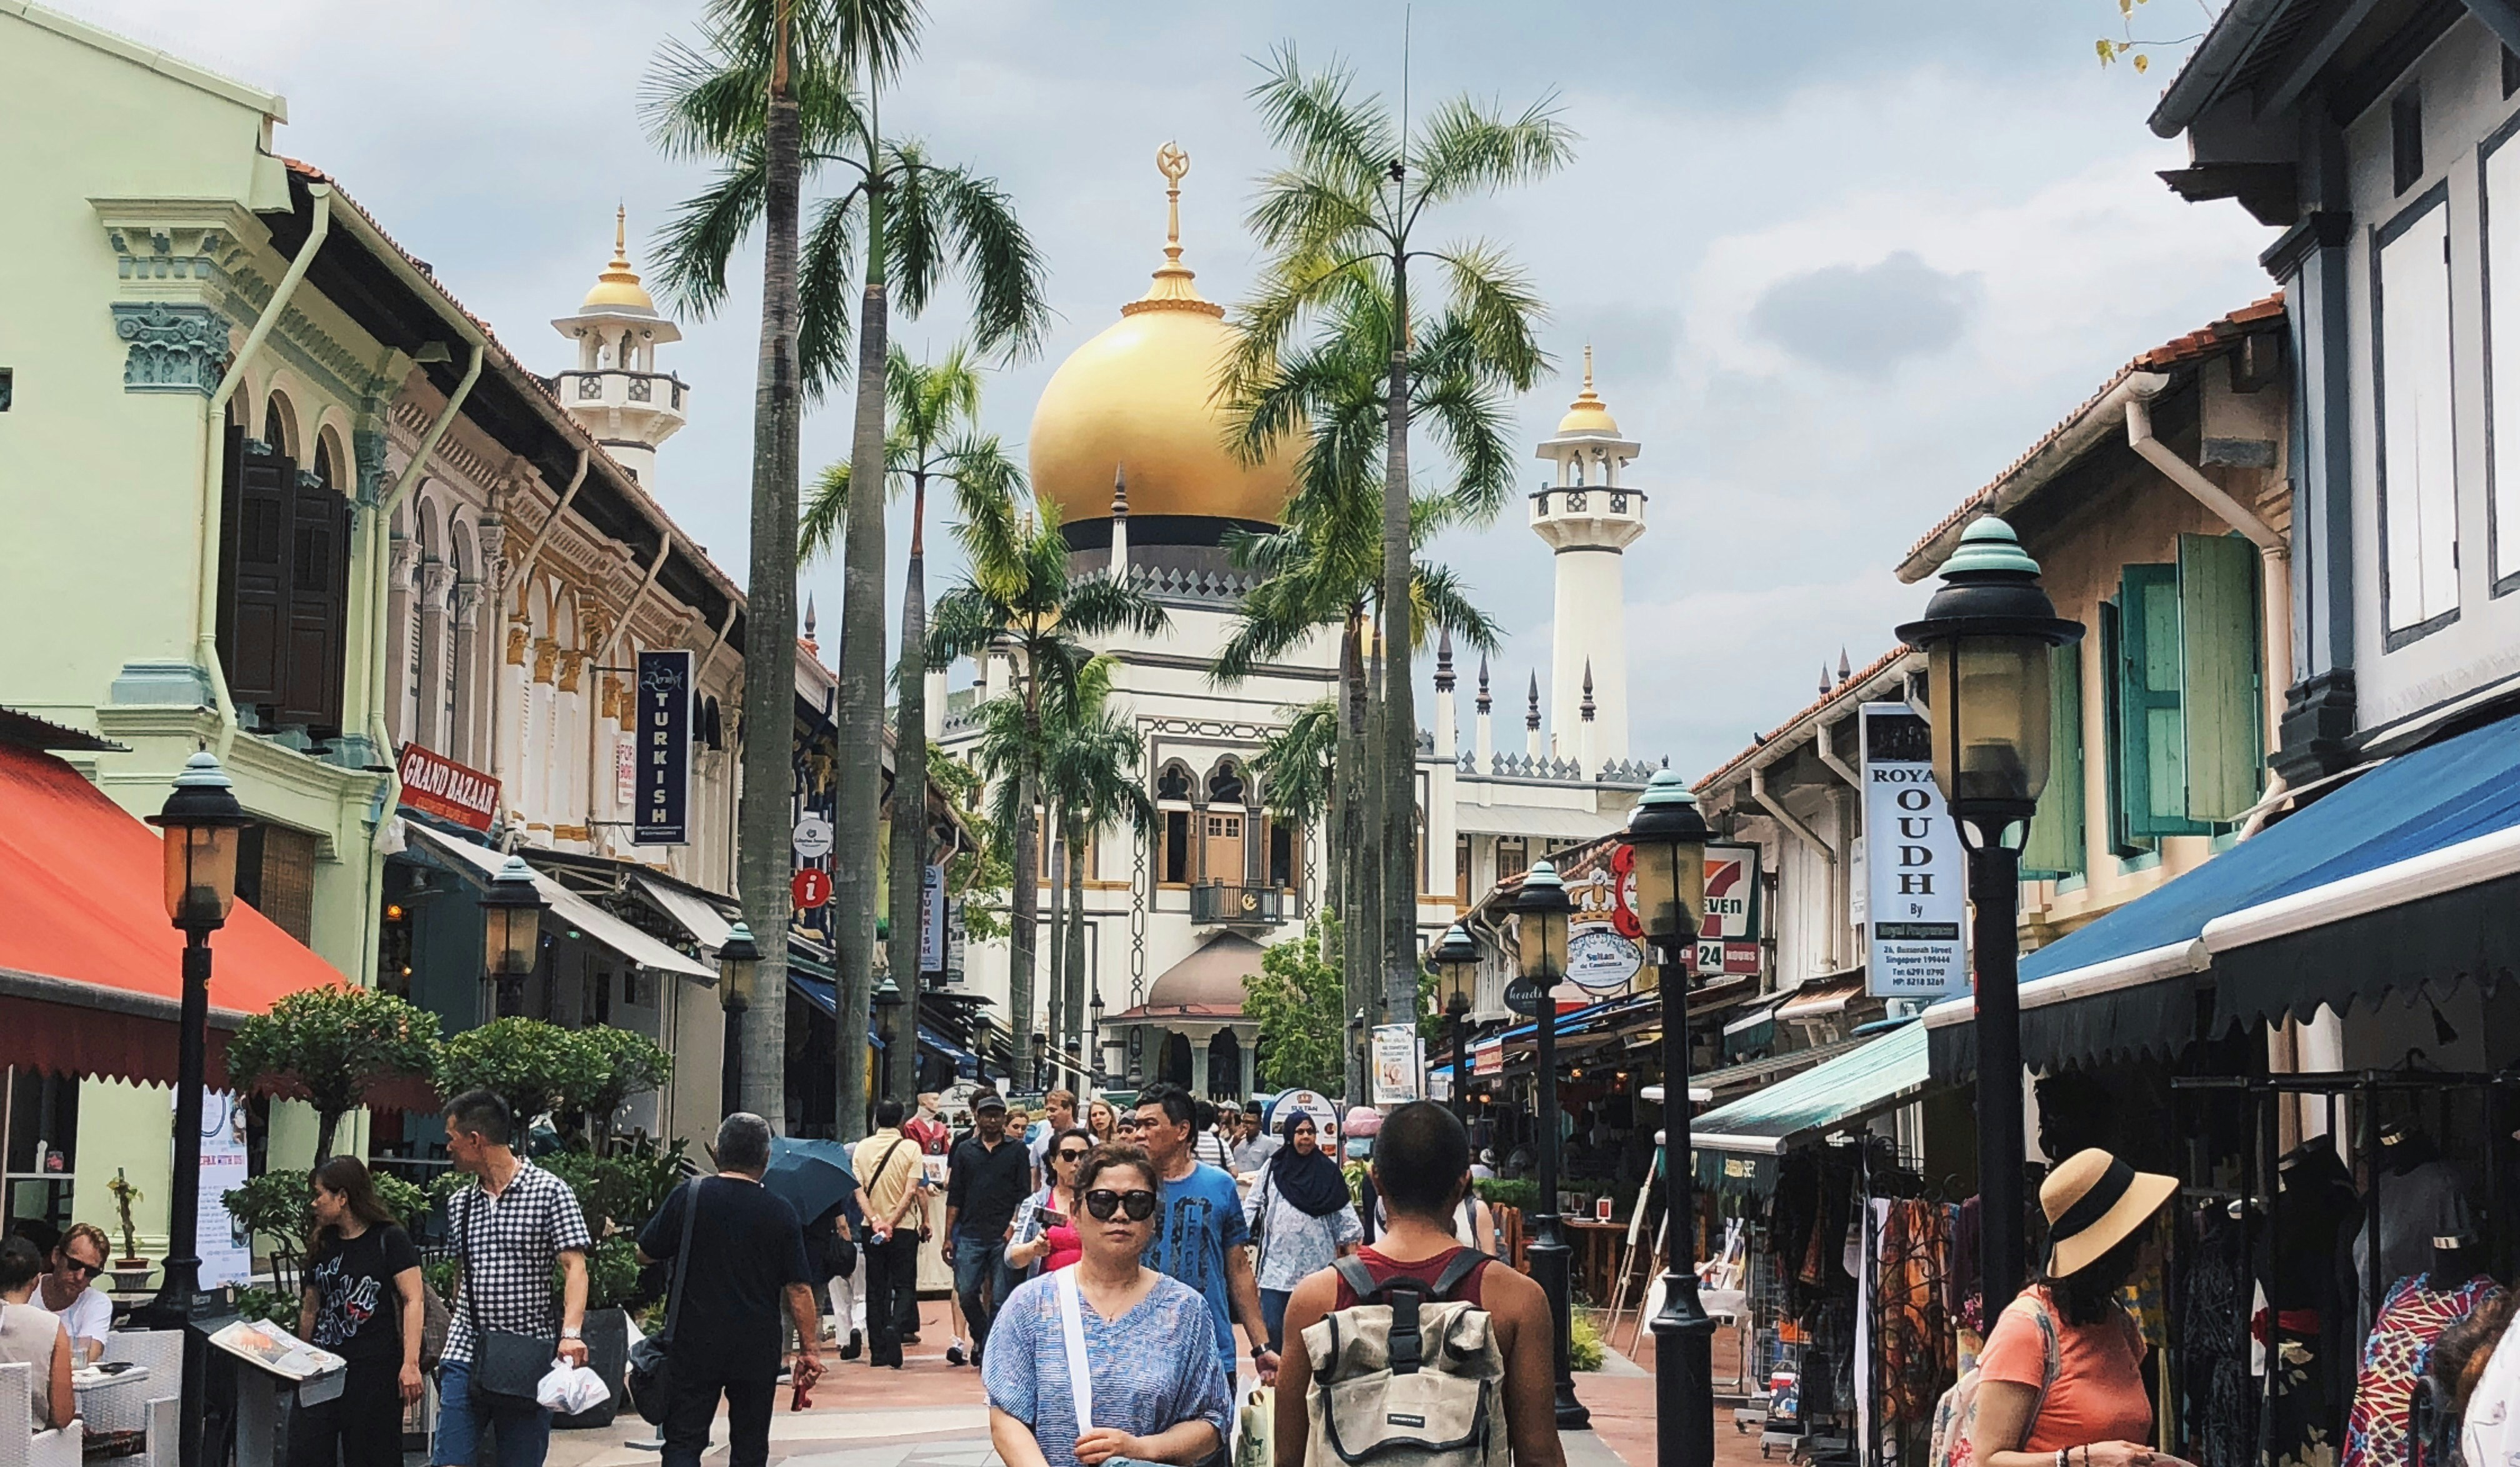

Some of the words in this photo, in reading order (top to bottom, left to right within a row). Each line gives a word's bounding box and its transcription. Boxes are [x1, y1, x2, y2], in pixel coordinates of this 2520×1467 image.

[652, 693, 668, 823] TURKISH
[403, 753, 449, 796] GRAND
[445, 769, 495, 815] BAZAAR
[1872, 769, 1937, 783] ROYA
[1897, 789, 1935, 895] OUDH
[1911, 903, 1922, 918] By
[922, 890, 932, 954] TURKISH
[1586, 953, 1615, 961] Sultan
[1699, 946, 1722, 966] 24
[1726, 950, 1755, 961] HOURS
[1886, 956, 1921, 965] Singapore
